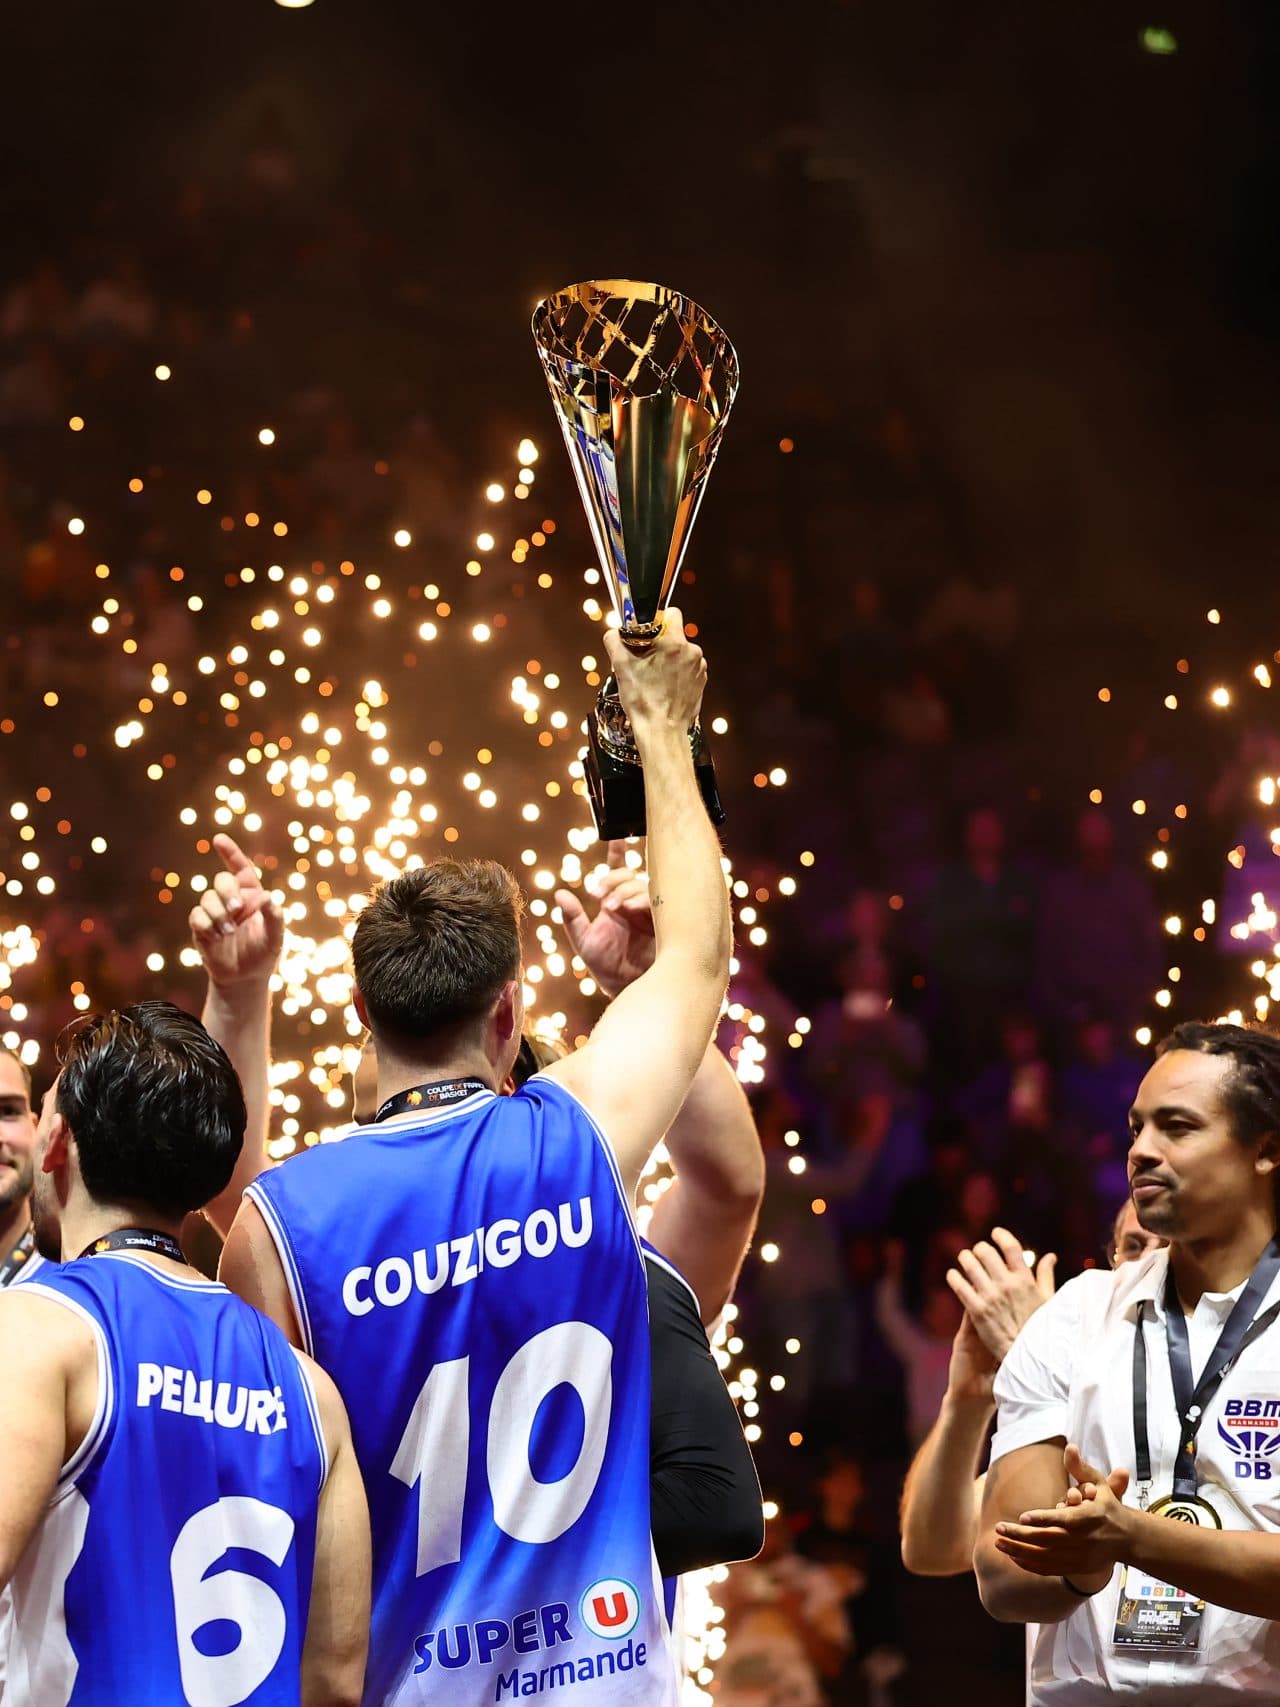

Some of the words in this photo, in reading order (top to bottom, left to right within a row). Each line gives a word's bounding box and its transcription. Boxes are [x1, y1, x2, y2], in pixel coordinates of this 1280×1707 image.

[427, 1085, 455, 1096] COUPE
[463, 1082, 485, 1090] FRANC
[342, 1196, 593, 1317] COUZIGOU
[388, 1321, 613, 1578] 10
[1234, 1461, 1272, 1480] DB
[170, 1496, 296, 1707] 6
[413, 1602, 574, 1684] SUPER
[592, 1592, 629, 1627] U
[496, 1639, 647, 1702] Marmande
